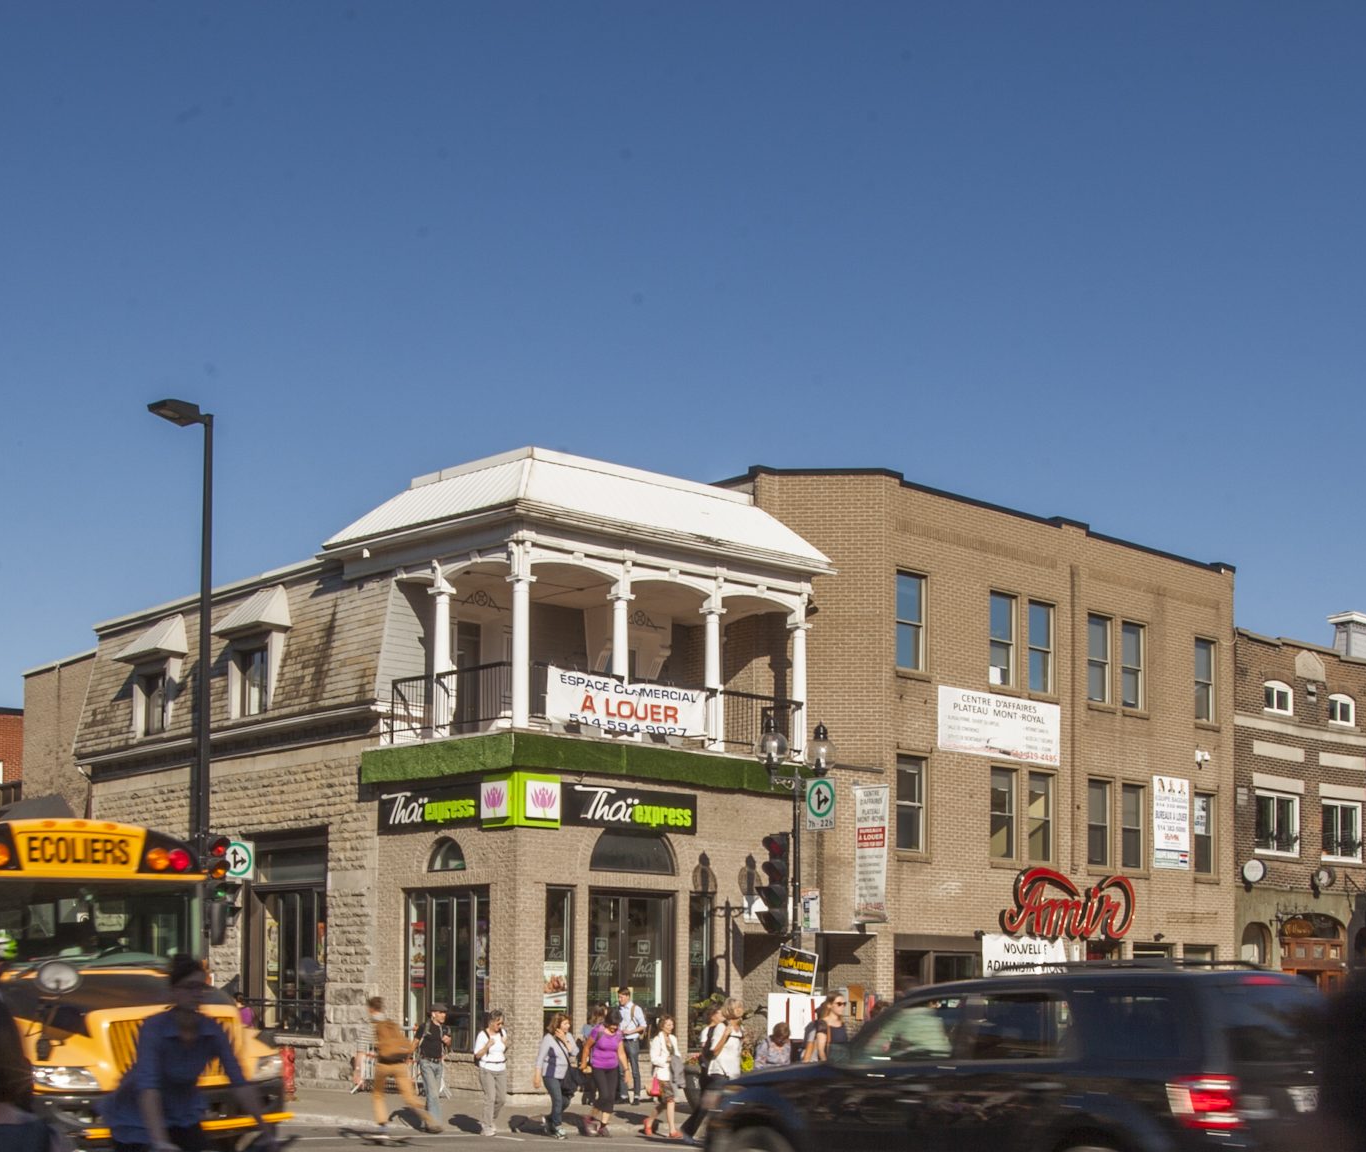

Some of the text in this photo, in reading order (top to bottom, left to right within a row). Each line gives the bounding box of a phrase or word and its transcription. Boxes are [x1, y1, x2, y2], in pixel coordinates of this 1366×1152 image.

[560, 674, 610, 692] ESPACE
[581, 690, 679, 724] À LOUER
[953, 702, 989, 715] PLATEAU
[961, 694, 1037, 714] CENTRE D'AFFAIRES
[423, 799, 476, 824] express
[634, 804, 693, 828] express
[27, 836, 131, 865] ECOLIERS
[1001, 866, 1135, 940] Amir
[1004, 942, 1048, 955] NOUVELLE
